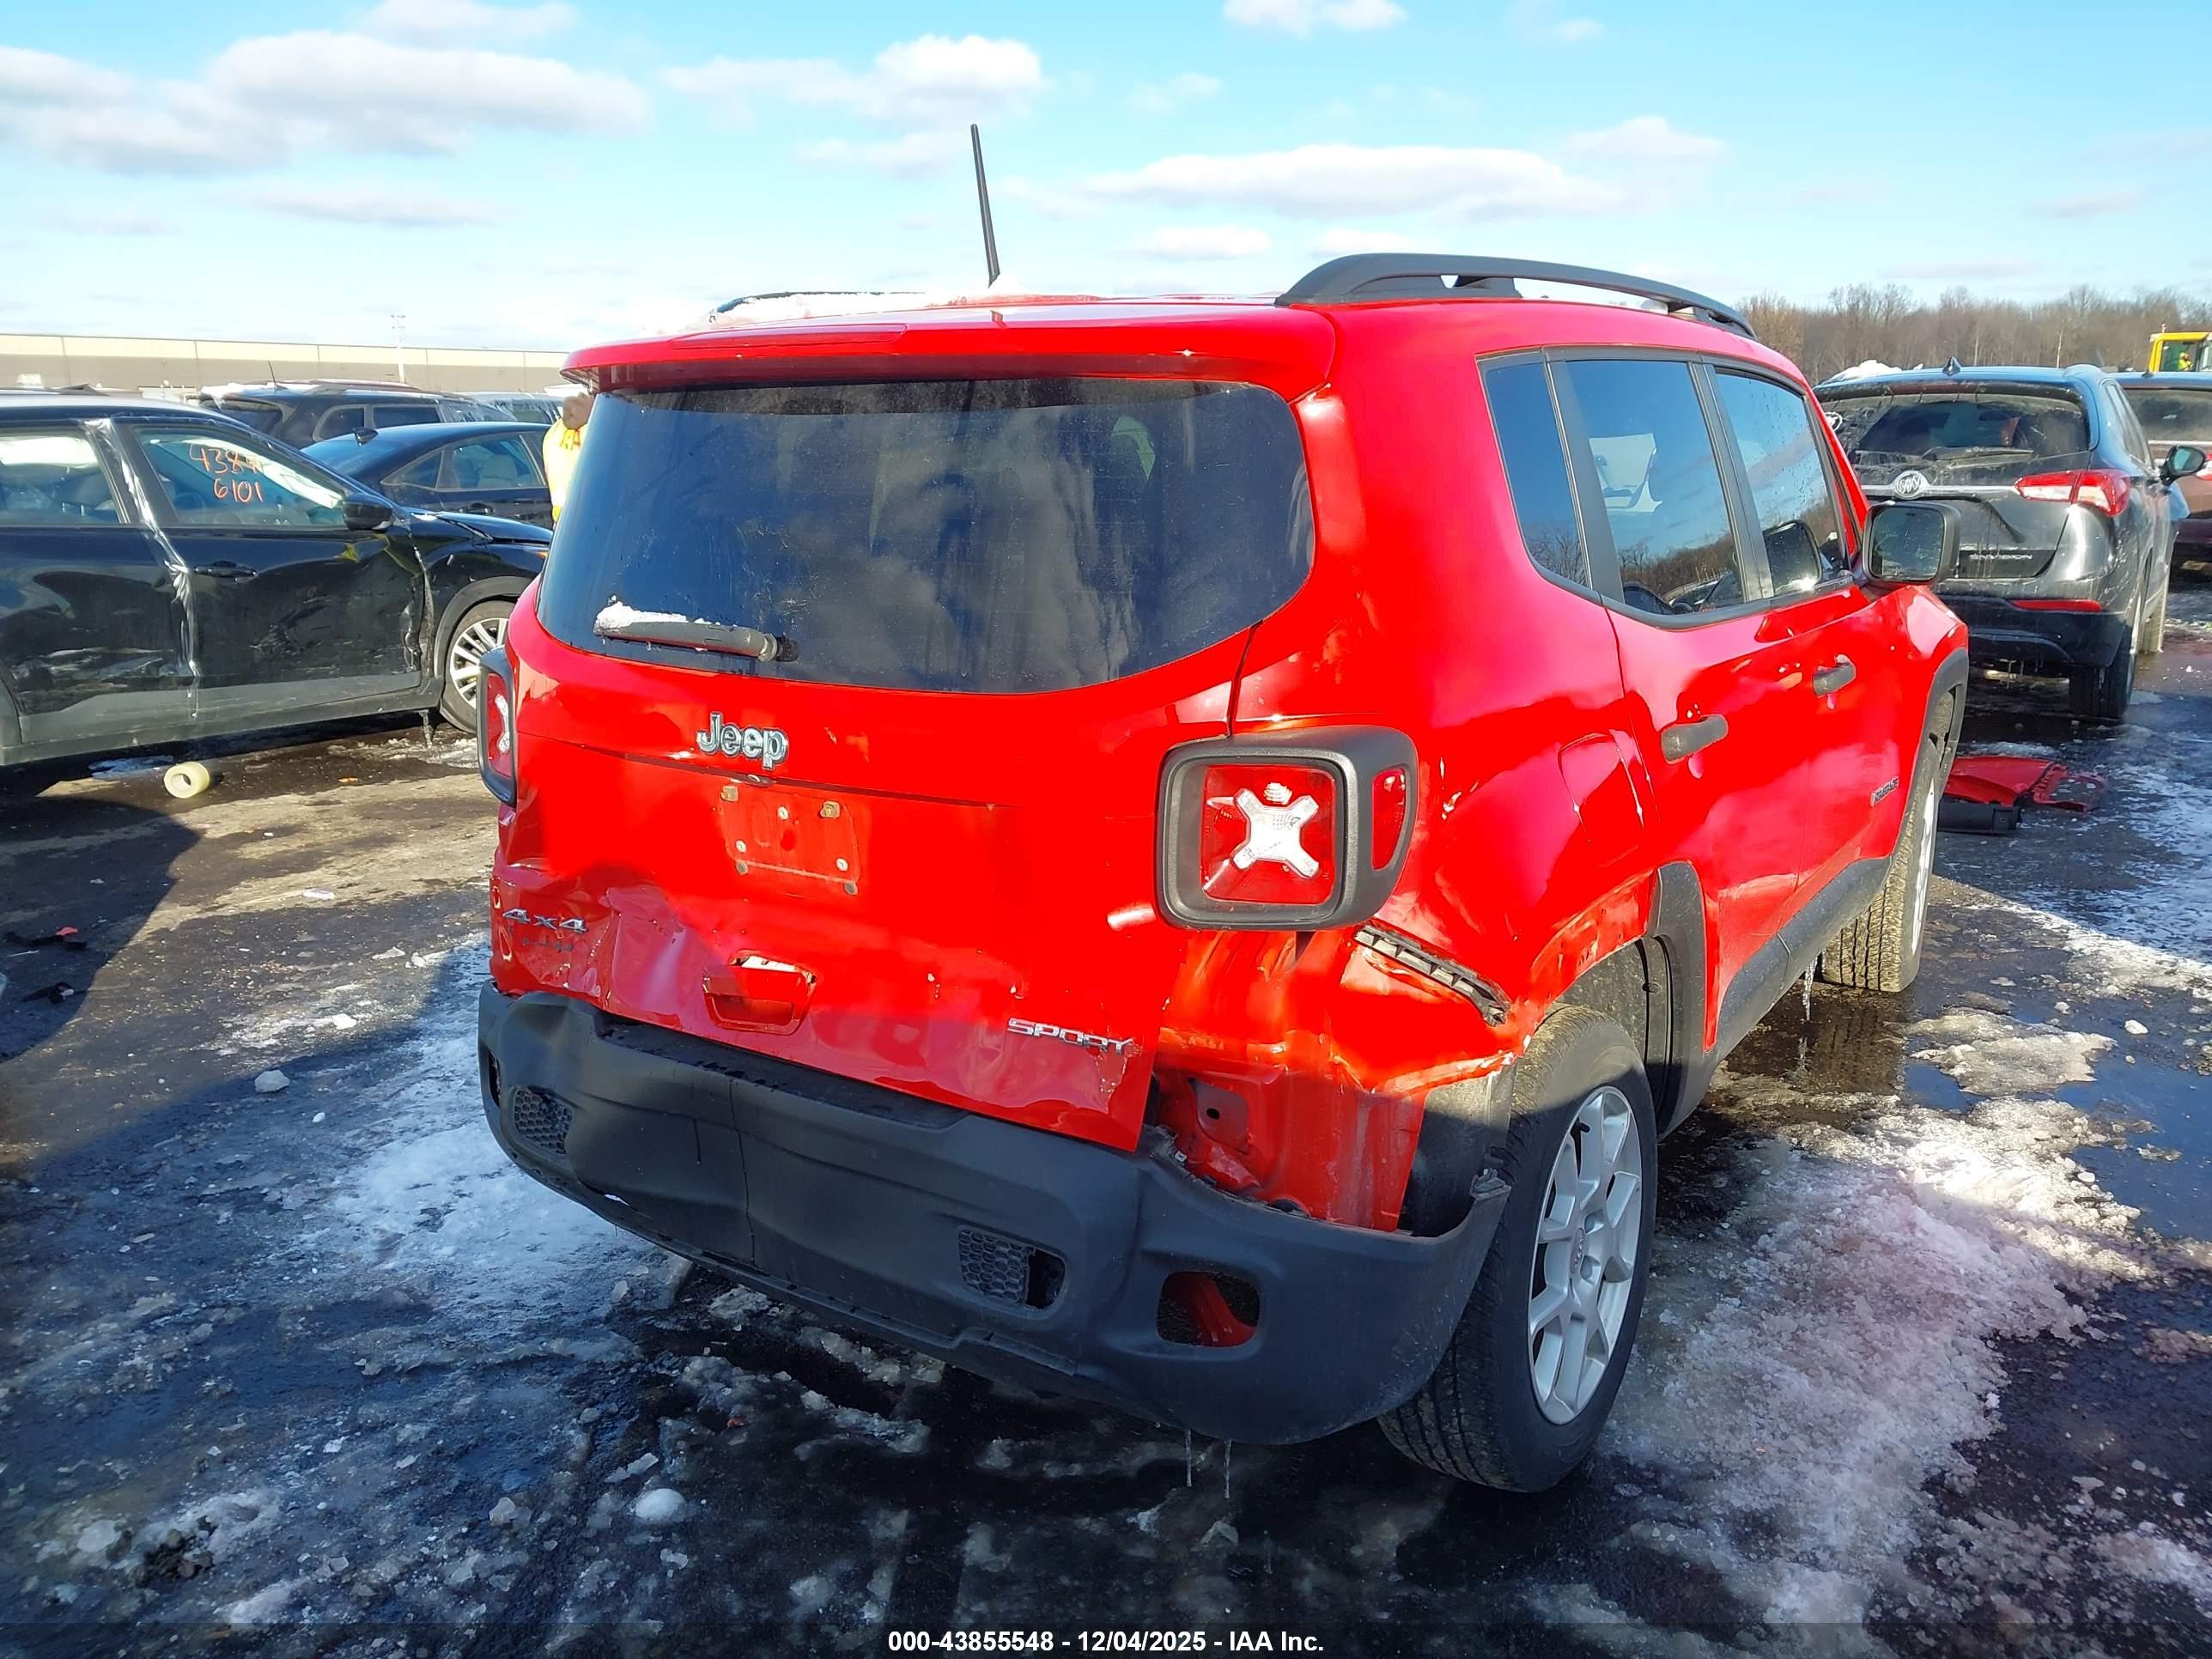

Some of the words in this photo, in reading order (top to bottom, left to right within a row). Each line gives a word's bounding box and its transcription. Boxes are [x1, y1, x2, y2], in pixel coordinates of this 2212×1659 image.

[214, 478, 264, 502] 6101
[696, 712, 789, 769] Jeep
[1007, 1018, 1134, 1054] SPORT
